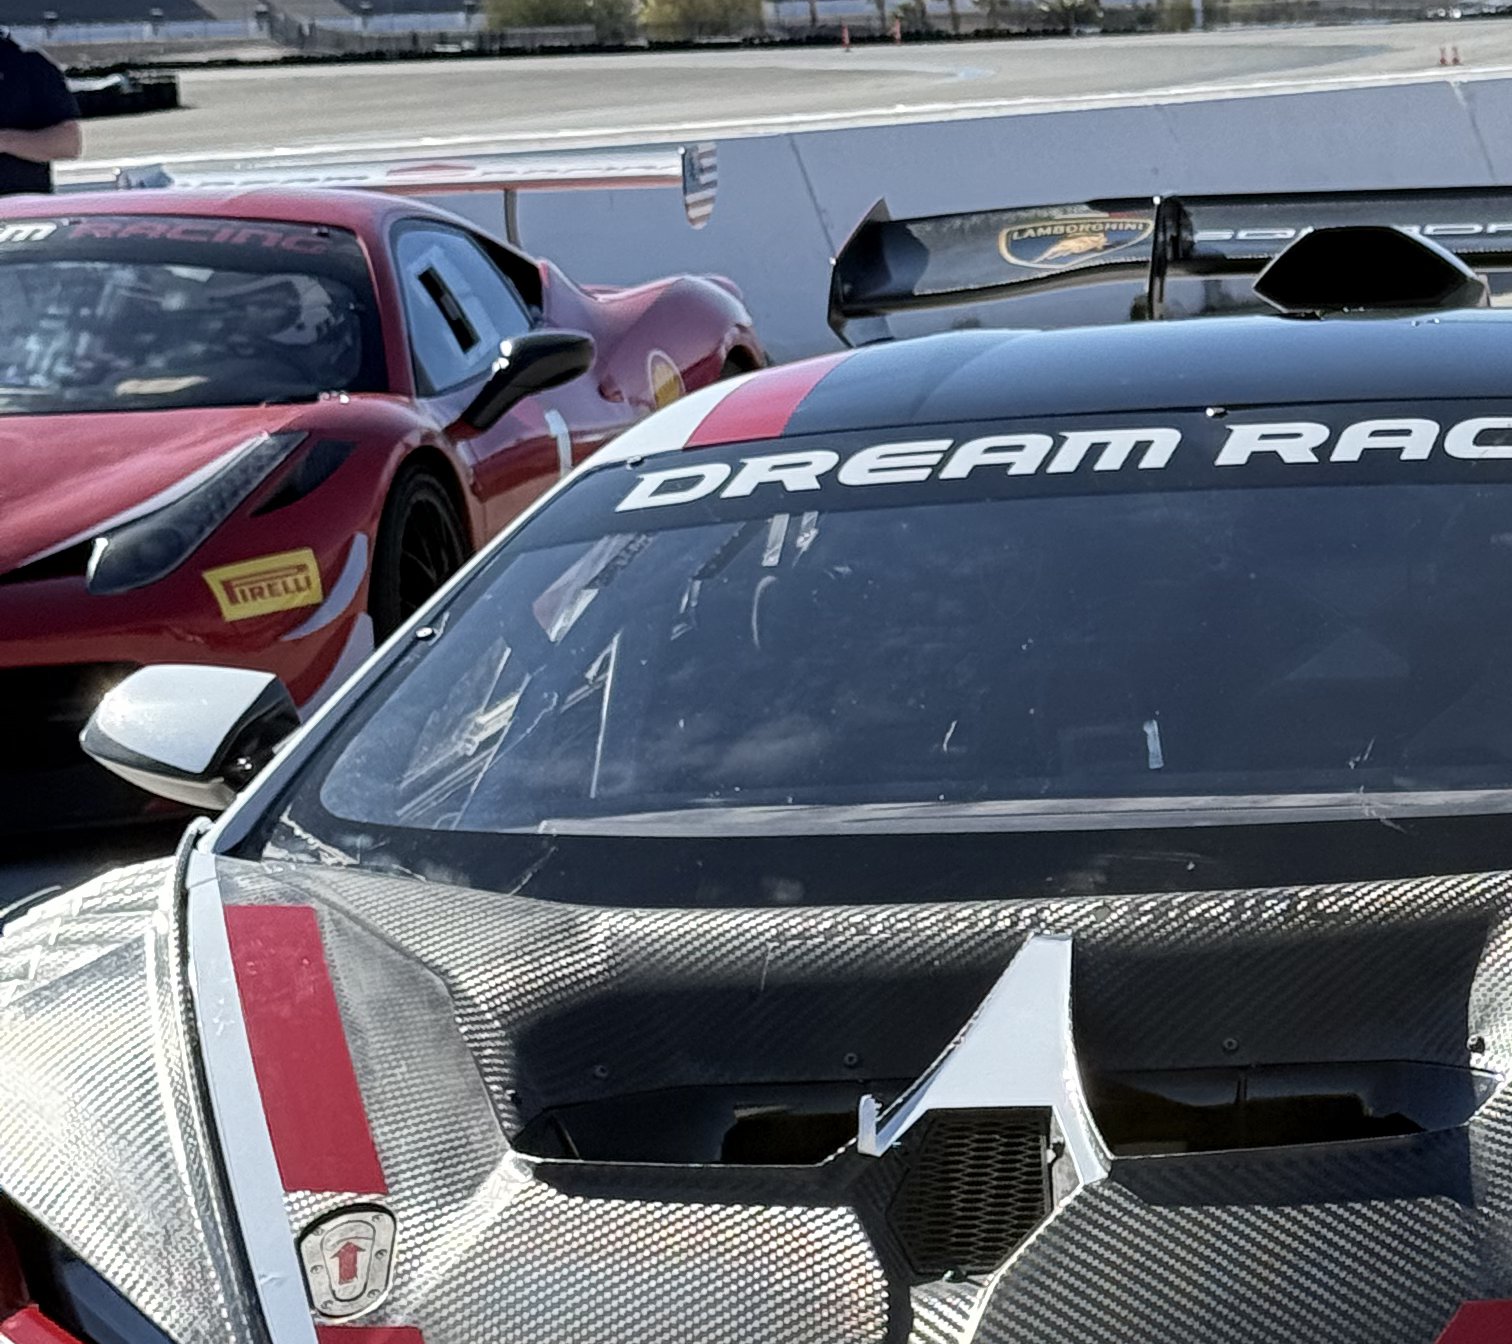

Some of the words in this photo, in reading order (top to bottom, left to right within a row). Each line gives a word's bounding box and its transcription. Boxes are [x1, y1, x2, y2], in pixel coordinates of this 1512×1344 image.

[67, 219, 329, 254] RACING
[1011, 221, 1144, 241] LAMBORGHINI
[614, 426, 1183, 513] DREAM
[220, 563, 312, 606] PIRELLI
